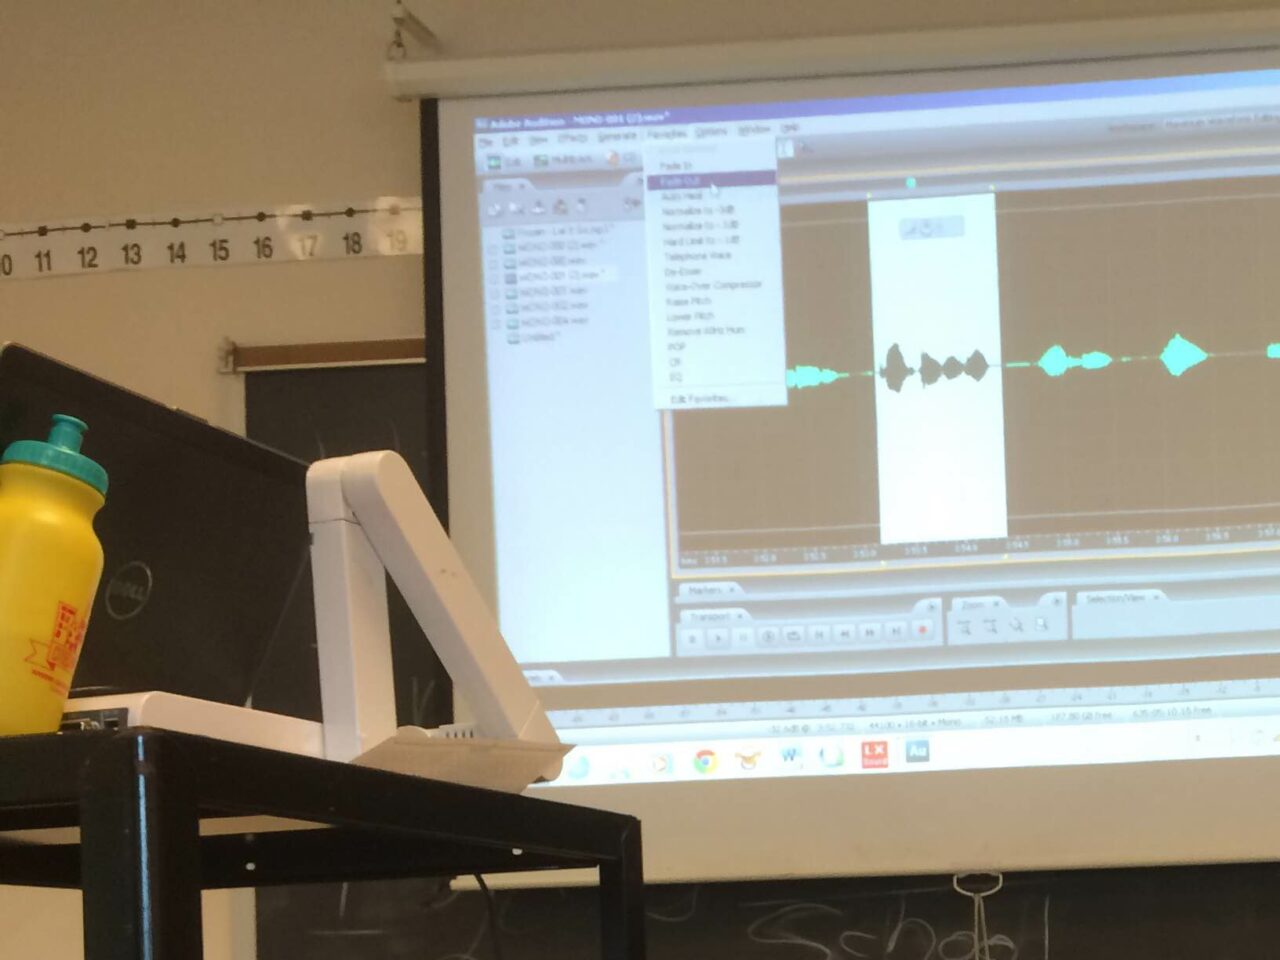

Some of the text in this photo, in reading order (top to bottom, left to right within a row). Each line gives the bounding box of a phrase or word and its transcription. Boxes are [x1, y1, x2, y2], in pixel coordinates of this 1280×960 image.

[1, 230, 407, 276] 0 11 12 13 14 15 16 17 18 19
[909, 744, 928, 758] Au
